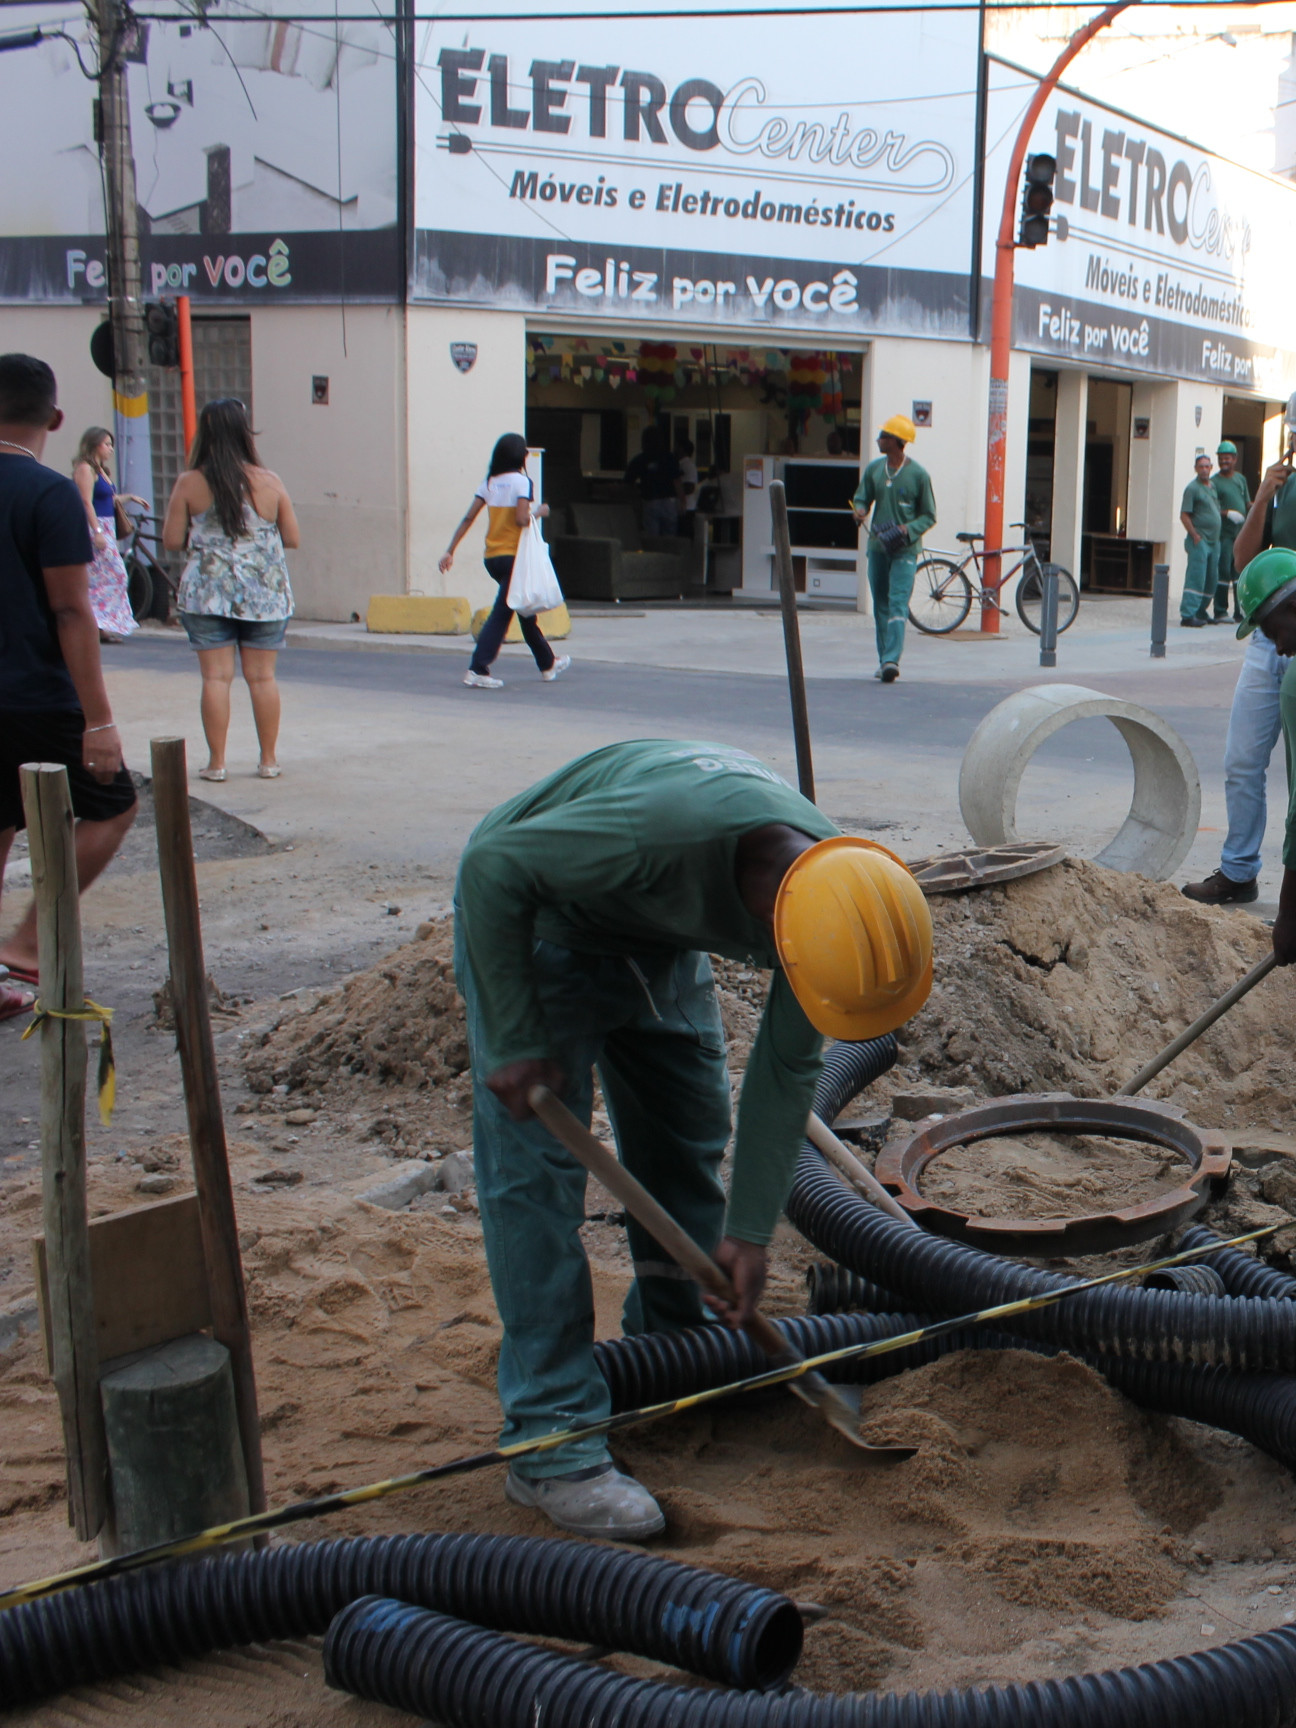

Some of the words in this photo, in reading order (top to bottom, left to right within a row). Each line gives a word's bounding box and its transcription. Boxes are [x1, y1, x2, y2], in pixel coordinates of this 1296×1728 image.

[717, 76, 925, 173] Center
[509, 169, 619, 207] Móveis
[628, 188, 646, 210] e
[655, 182, 895, 232] Eletrodomésticos
[1055, 108, 1192, 245] ELETRO
[151, 262, 197, 296] por
[546, 254, 657, 301] Feliz
[673, 275, 736, 310] por
[1086, 254, 1138, 301] Móveis
[1143, 280, 1151, 301] e
[1039, 303, 1080, 344] Feliz
[1084, 324, 1108, 352] por
[1202, 340, 1232, 371] Feliz
[1234, 357, 1251, 378] por
